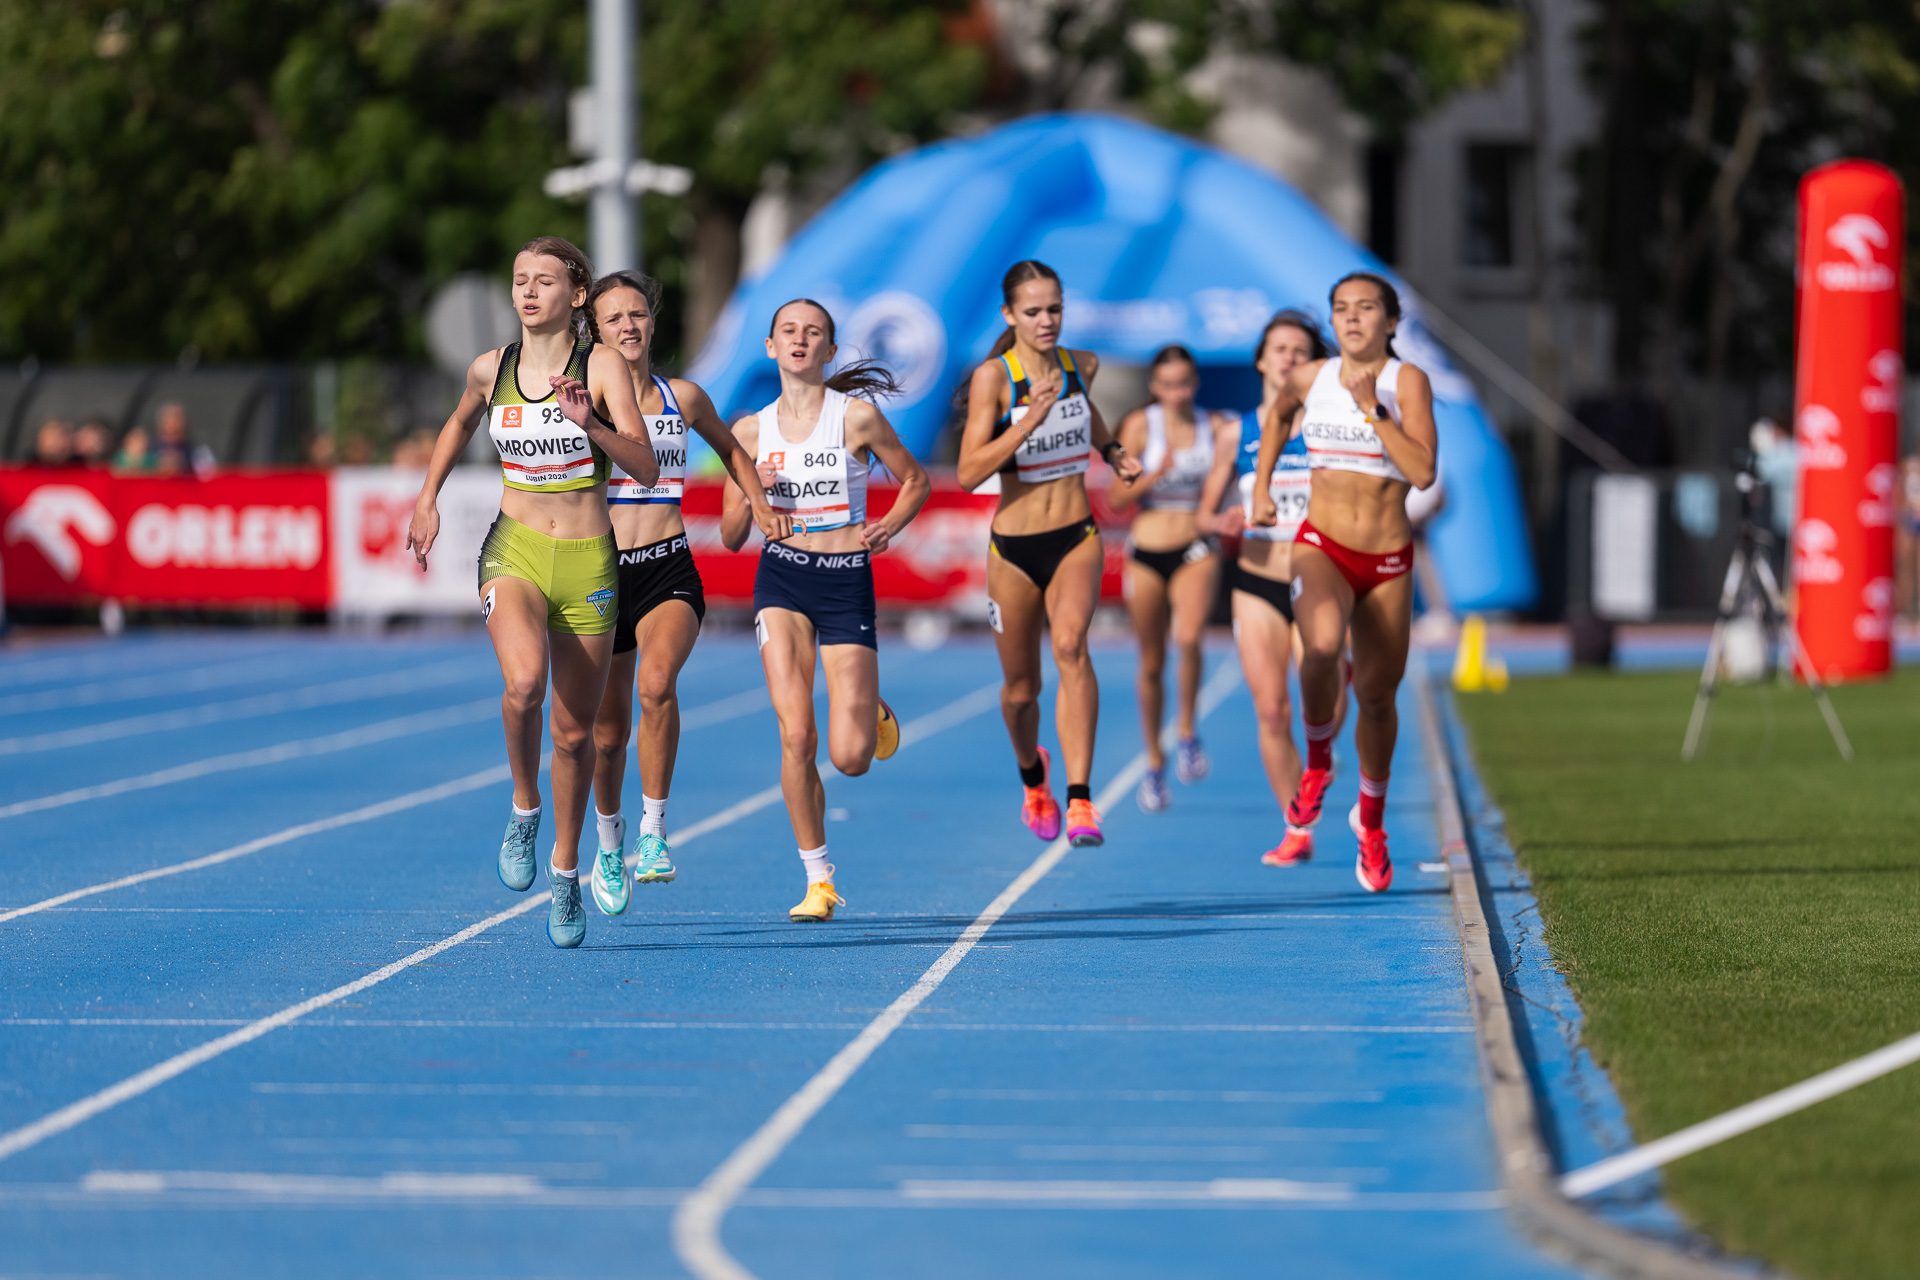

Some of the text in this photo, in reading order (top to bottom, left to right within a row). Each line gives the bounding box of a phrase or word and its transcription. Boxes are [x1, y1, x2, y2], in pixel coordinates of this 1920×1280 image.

[541, 406, 568, 424] 93
[1061, 401, 1084, 419] 125
[655, 419, 683, 435] 915
[496, 436, 585, 457] MROWIEC
[1027, 428, 1086, 455] FILIPEK
[655, 448, 686, 467] WKA
[804, 452, 837, 467] 840
[525, 474, 547, 482] LUBIN
[127, 503, 323, 570] ORLEN
[618, 542, 668, 566] NIKE
[767, 543, 864, 568] PRO NIKE
